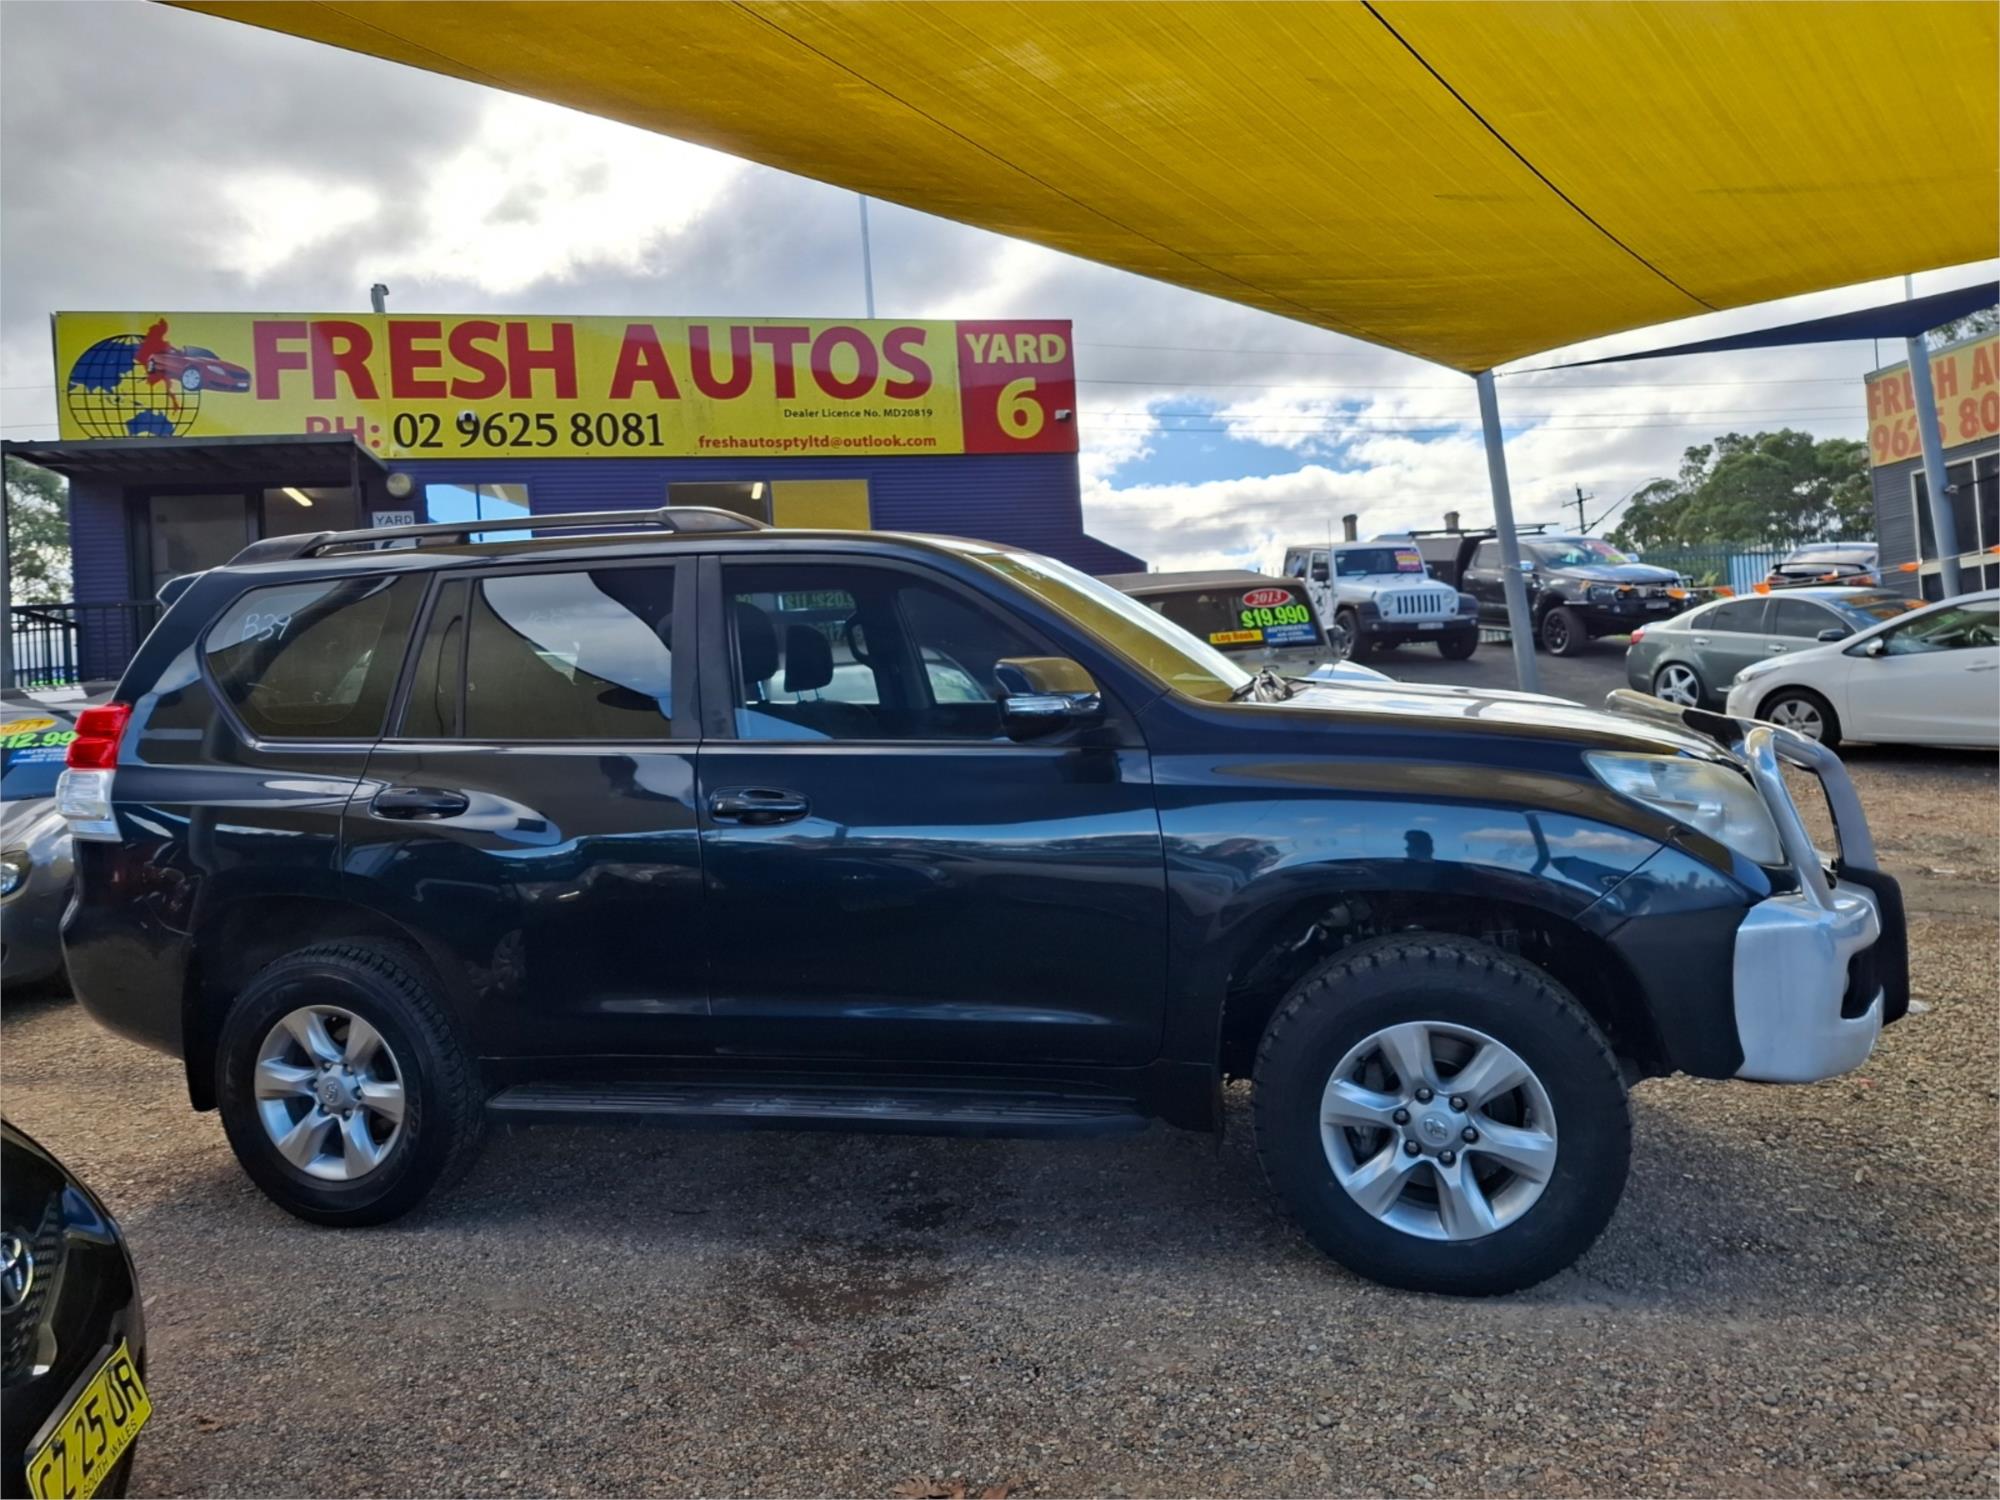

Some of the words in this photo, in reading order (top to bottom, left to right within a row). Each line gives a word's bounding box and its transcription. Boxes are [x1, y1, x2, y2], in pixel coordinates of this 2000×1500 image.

[253, 320, 578, 400] FRESH
[609, 324, 933, 401] AUTOS
[964, 333, 1067, 365] YARD
[1867, 355, 1958, 421] FRH
[783, 408, 819, 418] Dealer
[822, 408, 861, 418] Licence
[863, 408, 881, 418] No.
[883, 408, 933, 418] MD20819
[996, 377, 1044, 440] 6
[393, 412, 443, 448] 02
[456, 411, 558, 448] 9625
[570, 412, 664, 447] 8081
[698, 434, 936, 450] freshautosptyltd@outlook.com
[375, 514, 413, 525] YARD
[241, 613, 292, 641] B39
[1241, 604, 1310, 628] $19.990
[111, 1419, 137, 1457] WALES
